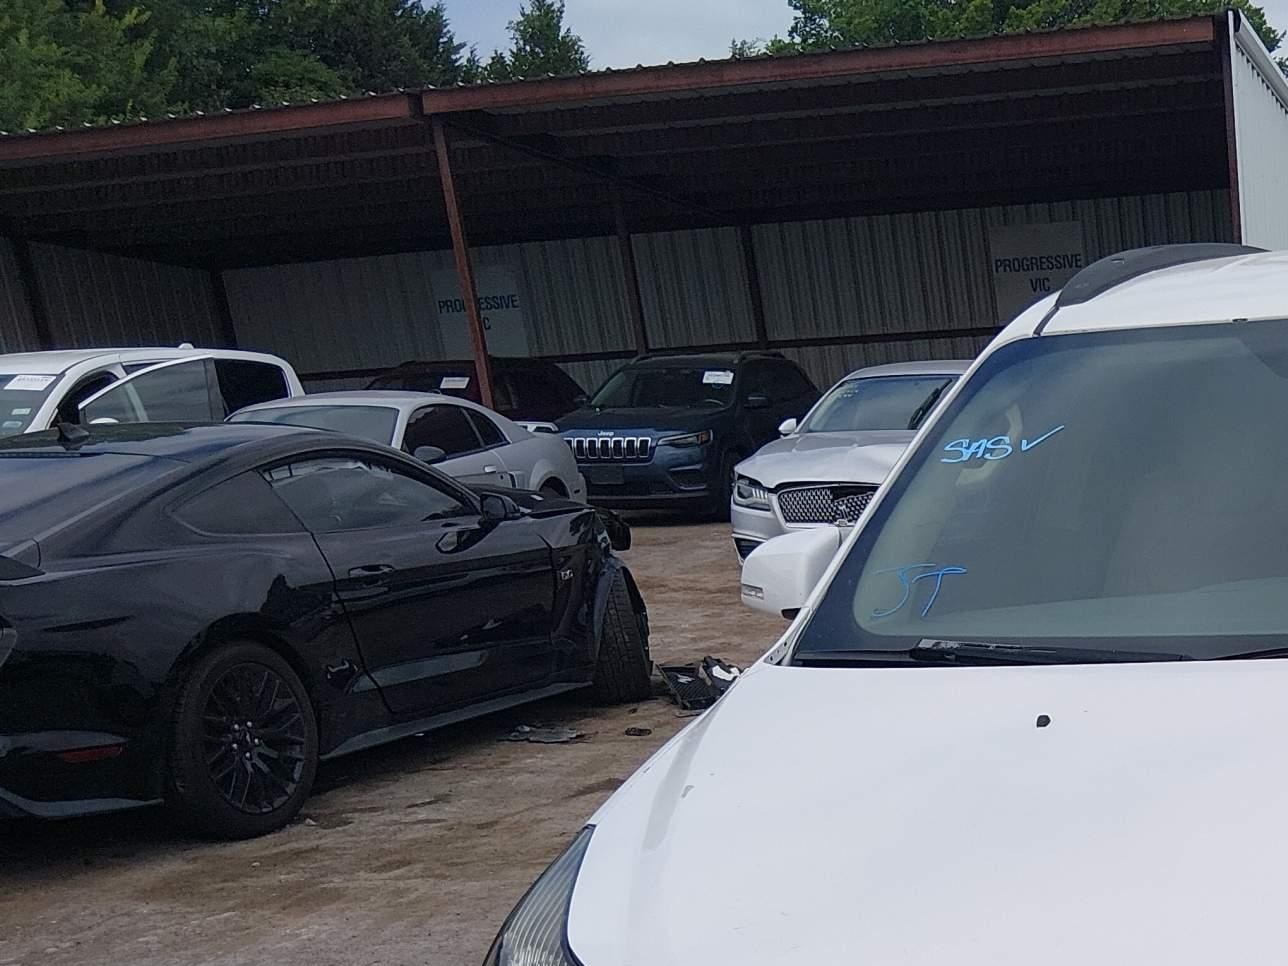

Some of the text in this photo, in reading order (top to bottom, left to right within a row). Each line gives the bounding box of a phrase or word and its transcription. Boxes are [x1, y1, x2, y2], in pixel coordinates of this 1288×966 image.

[995, 253, 1082, 273] PROGRESSIVE
[1030, 277, 1051, 293] VIC
[438, 295, 519, 314] PROESSIVE
[940, 435, 1013, 462] SAS
